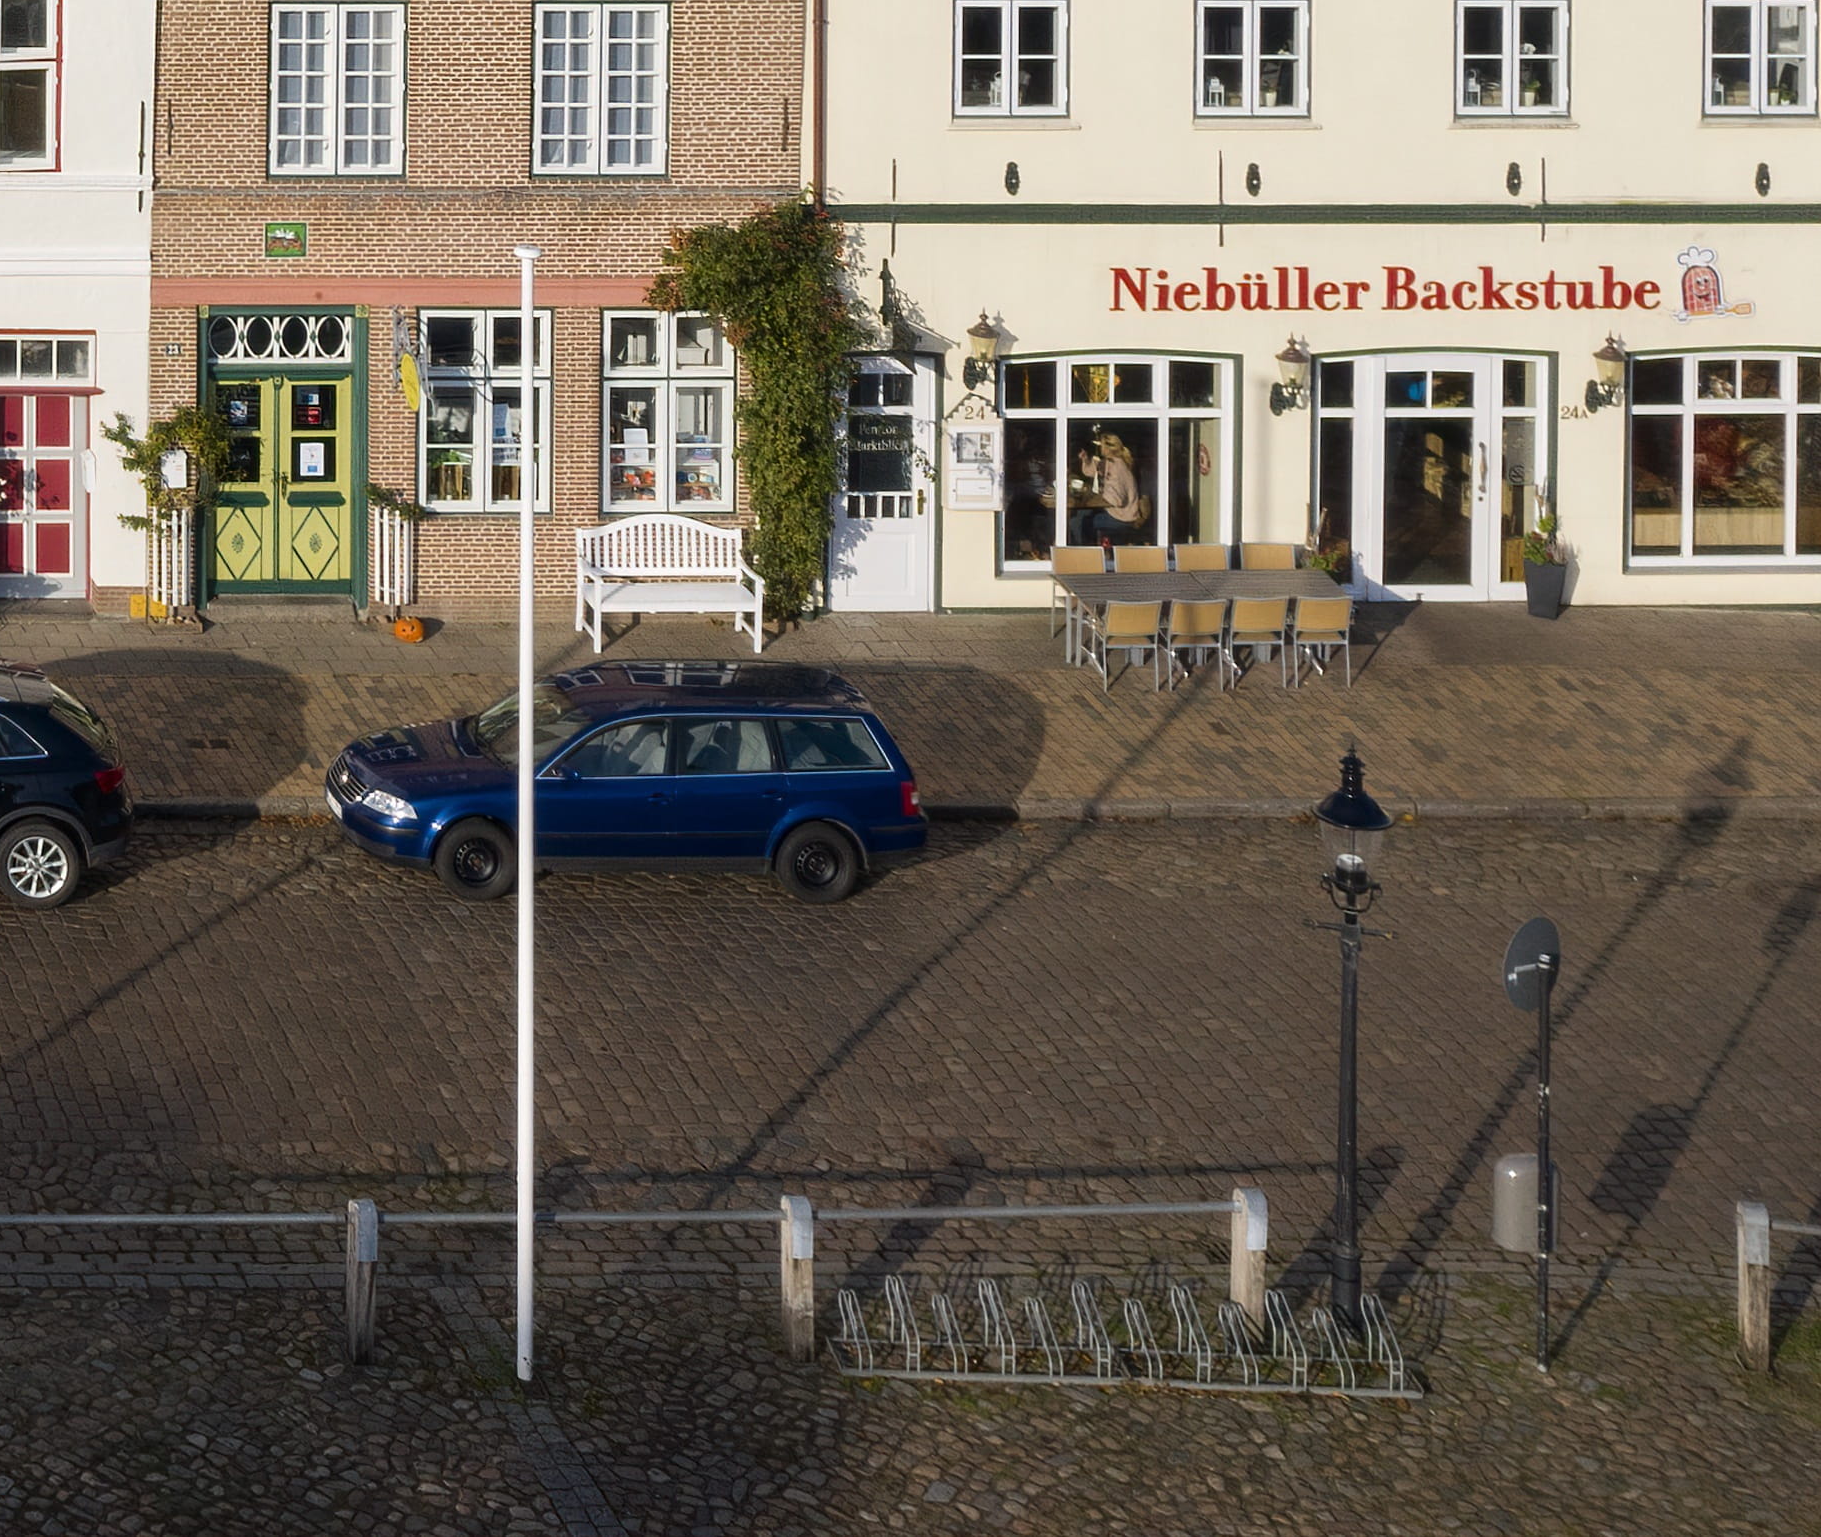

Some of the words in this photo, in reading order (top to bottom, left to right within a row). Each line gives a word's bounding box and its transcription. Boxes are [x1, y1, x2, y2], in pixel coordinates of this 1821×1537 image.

[1109, 266, 1370, 311] Niebüller
[1381, 266, 1660, 310] Backstube
[965, 405, 985, 420] 24
